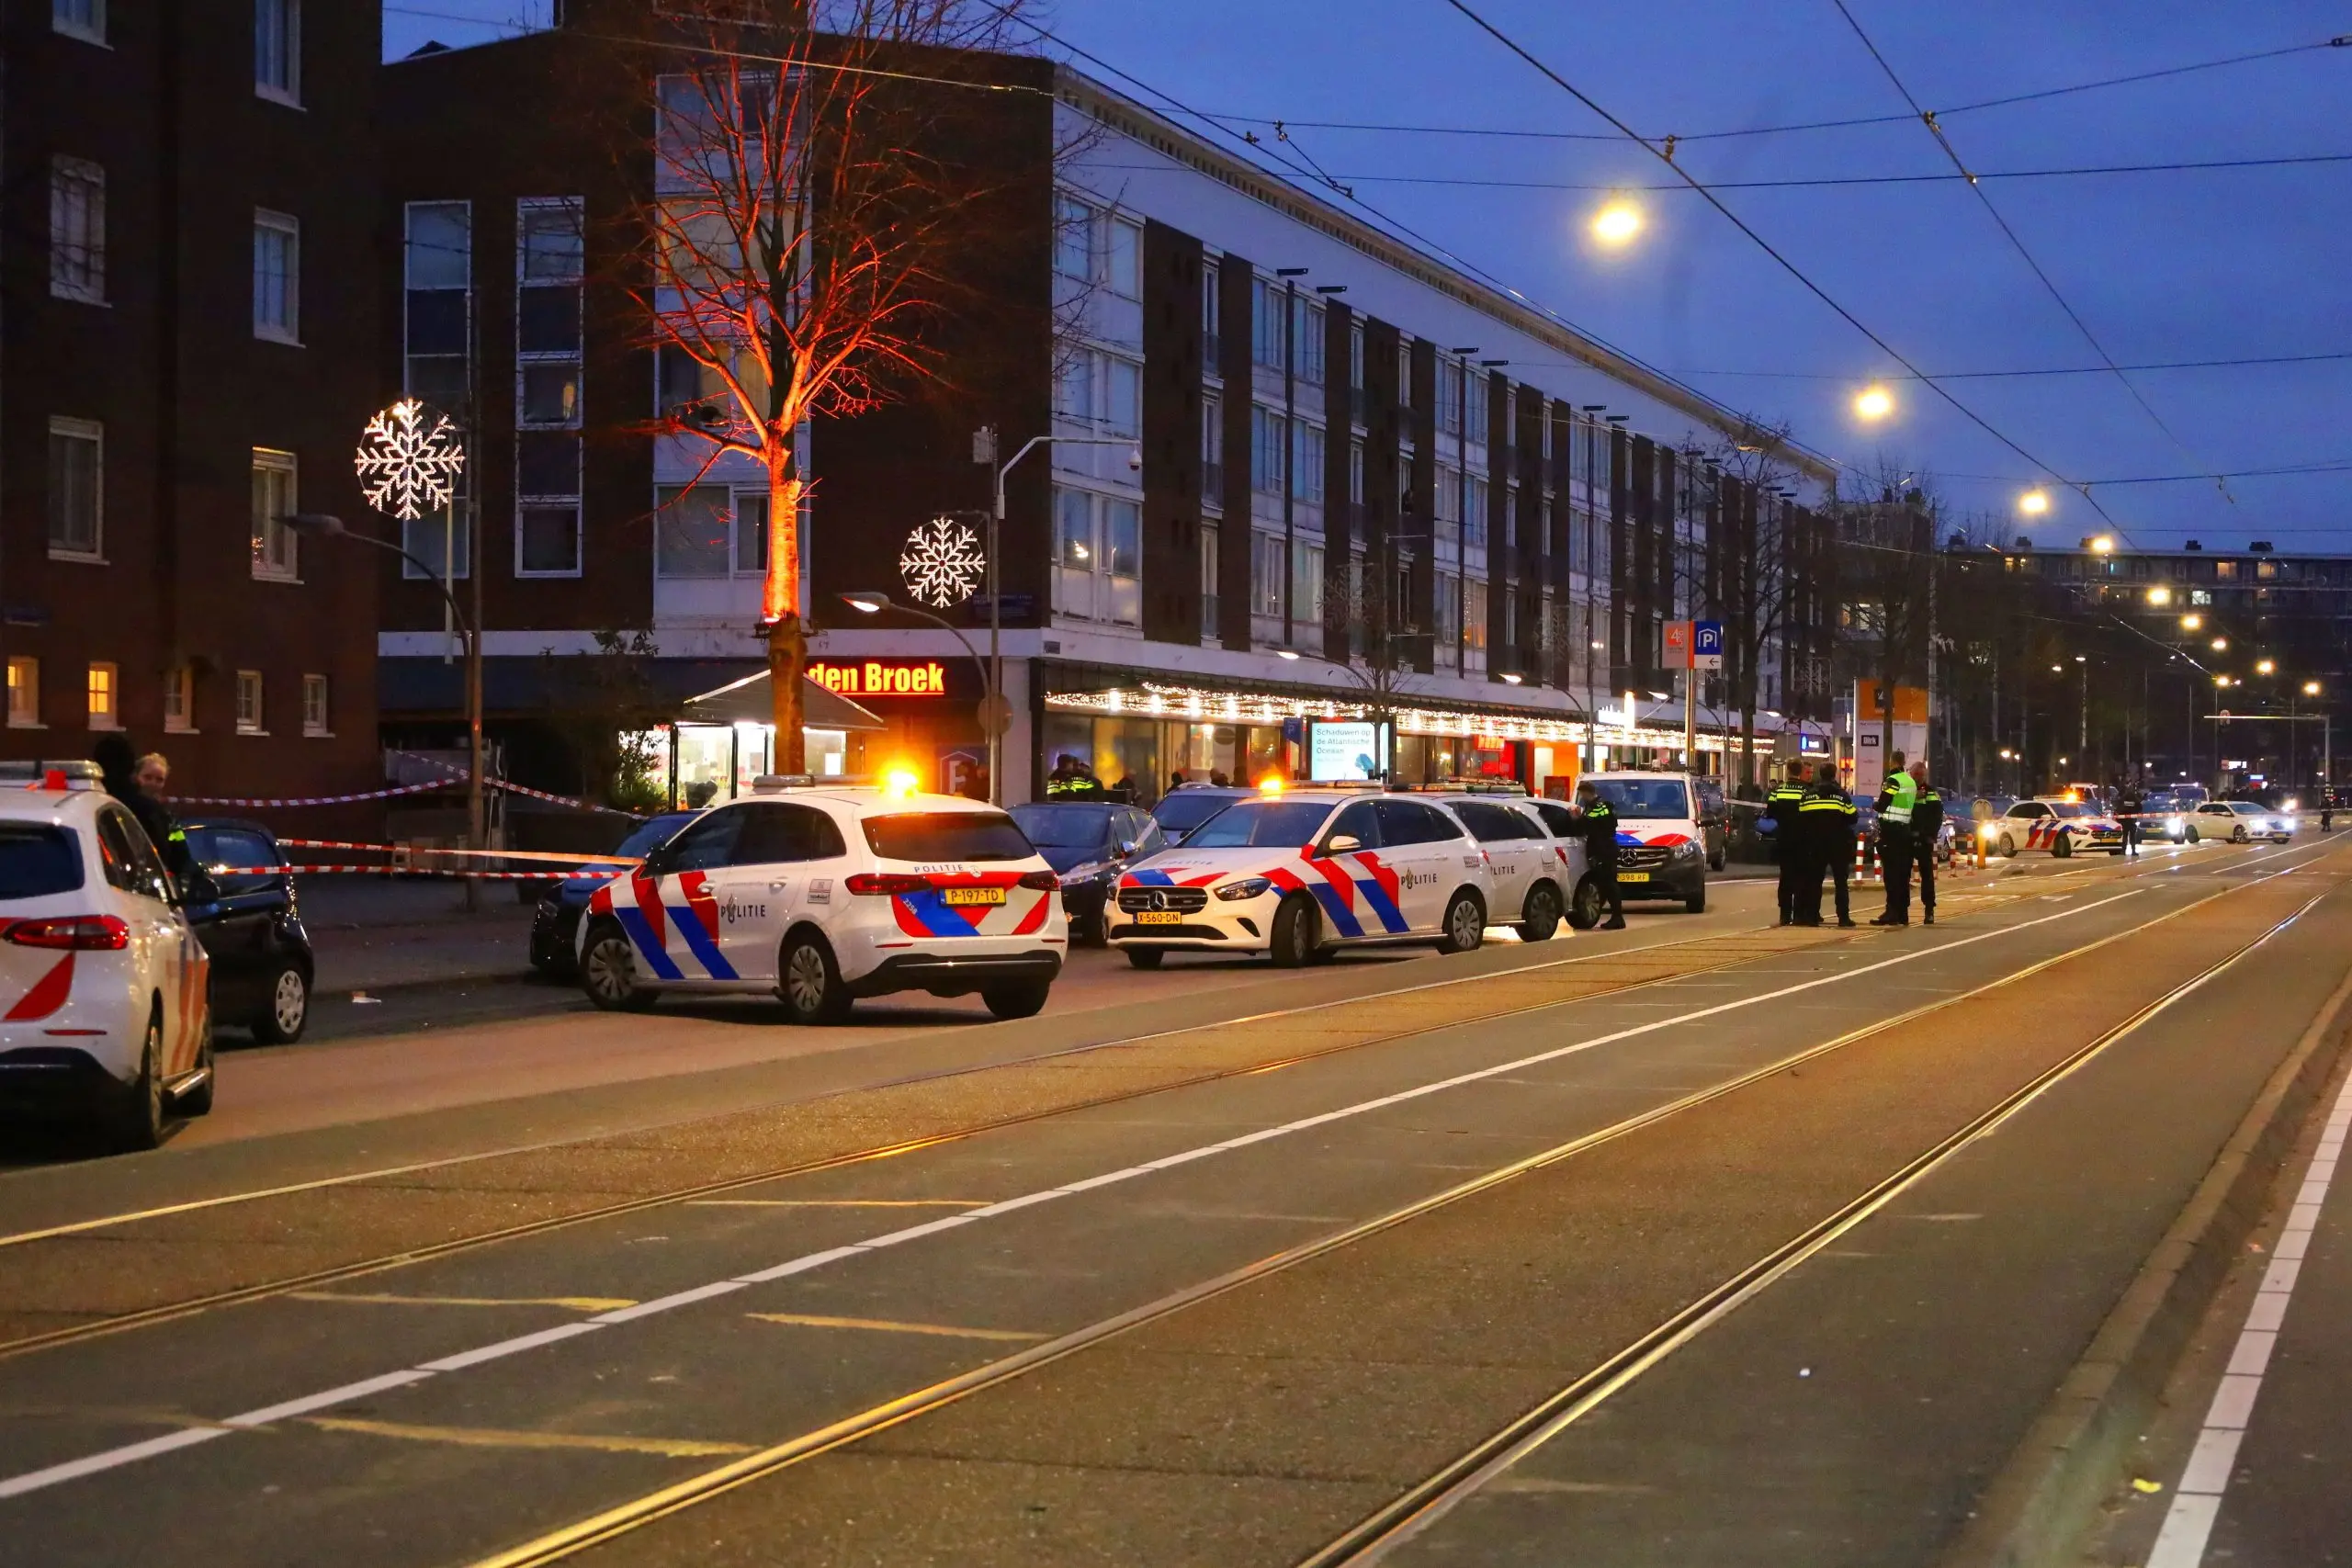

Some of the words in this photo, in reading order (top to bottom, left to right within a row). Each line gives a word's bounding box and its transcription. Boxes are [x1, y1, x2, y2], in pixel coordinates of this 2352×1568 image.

[1702, 633, 1713, 648] P
[808, 663, 858, 692] den
[865, 662, 944, 693] Broek
[1862, 736, 1877, 745] Dirk
[913, 863, 965, 874] POLITIE
[950, 889, 1000, 902] P-197-TD
[1138, 912, 1180, 923] X-560-DN
